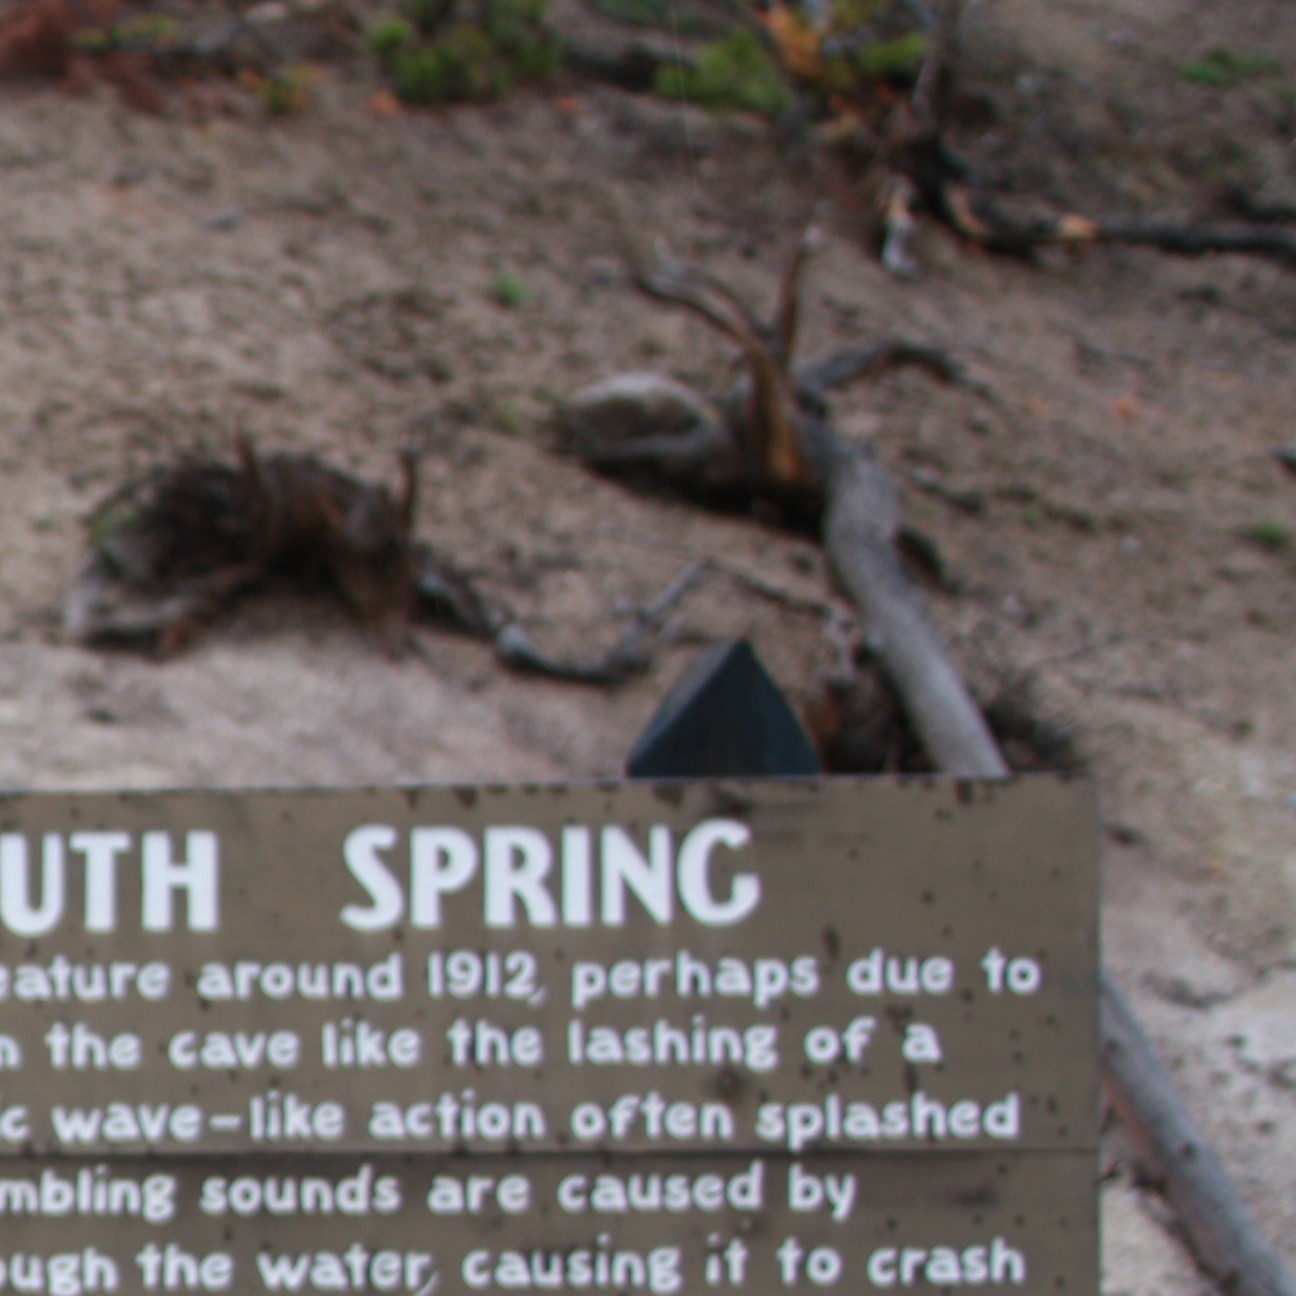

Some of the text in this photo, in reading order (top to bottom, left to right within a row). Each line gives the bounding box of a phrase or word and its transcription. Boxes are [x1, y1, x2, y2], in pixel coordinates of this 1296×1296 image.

[339, 819, 762, 934] SPRING
[196, 952, 404, 1002] around
[571, 950, 821, 1010] perhaps
[845, 947, 954, 996] due
[981, 947, 1042, 996] to
[44, 1022, 142, 1070] the
[167, 1030, 300, 1070] cave
[321, 1021, 422, 1068] like
[446, 1019, 543, 1067] the
[567, 1014, 779, 1073] lashing
[803, 1015, 877, 1065] of
[901, 1022, 943, 1064] a
[368, 1088, 546, 1141] action
[570, 1091, 735, 1142] often
[754, 1090, 1021, 1151] splashed
[200, 1166, 401, 1214] sounds
[427, 1175, 530, 1214] are
[557, 1161, 764, 1213] caused
[788, 1164, 857, 1223] by
[135, 1243, 234, 1291] the
[461, 1233, 684, 1296] causing
[704, 1232, 749, 1286] it
[776, 1237, 843, 1286] to
[866, 1236, 1026, 1288] crash
